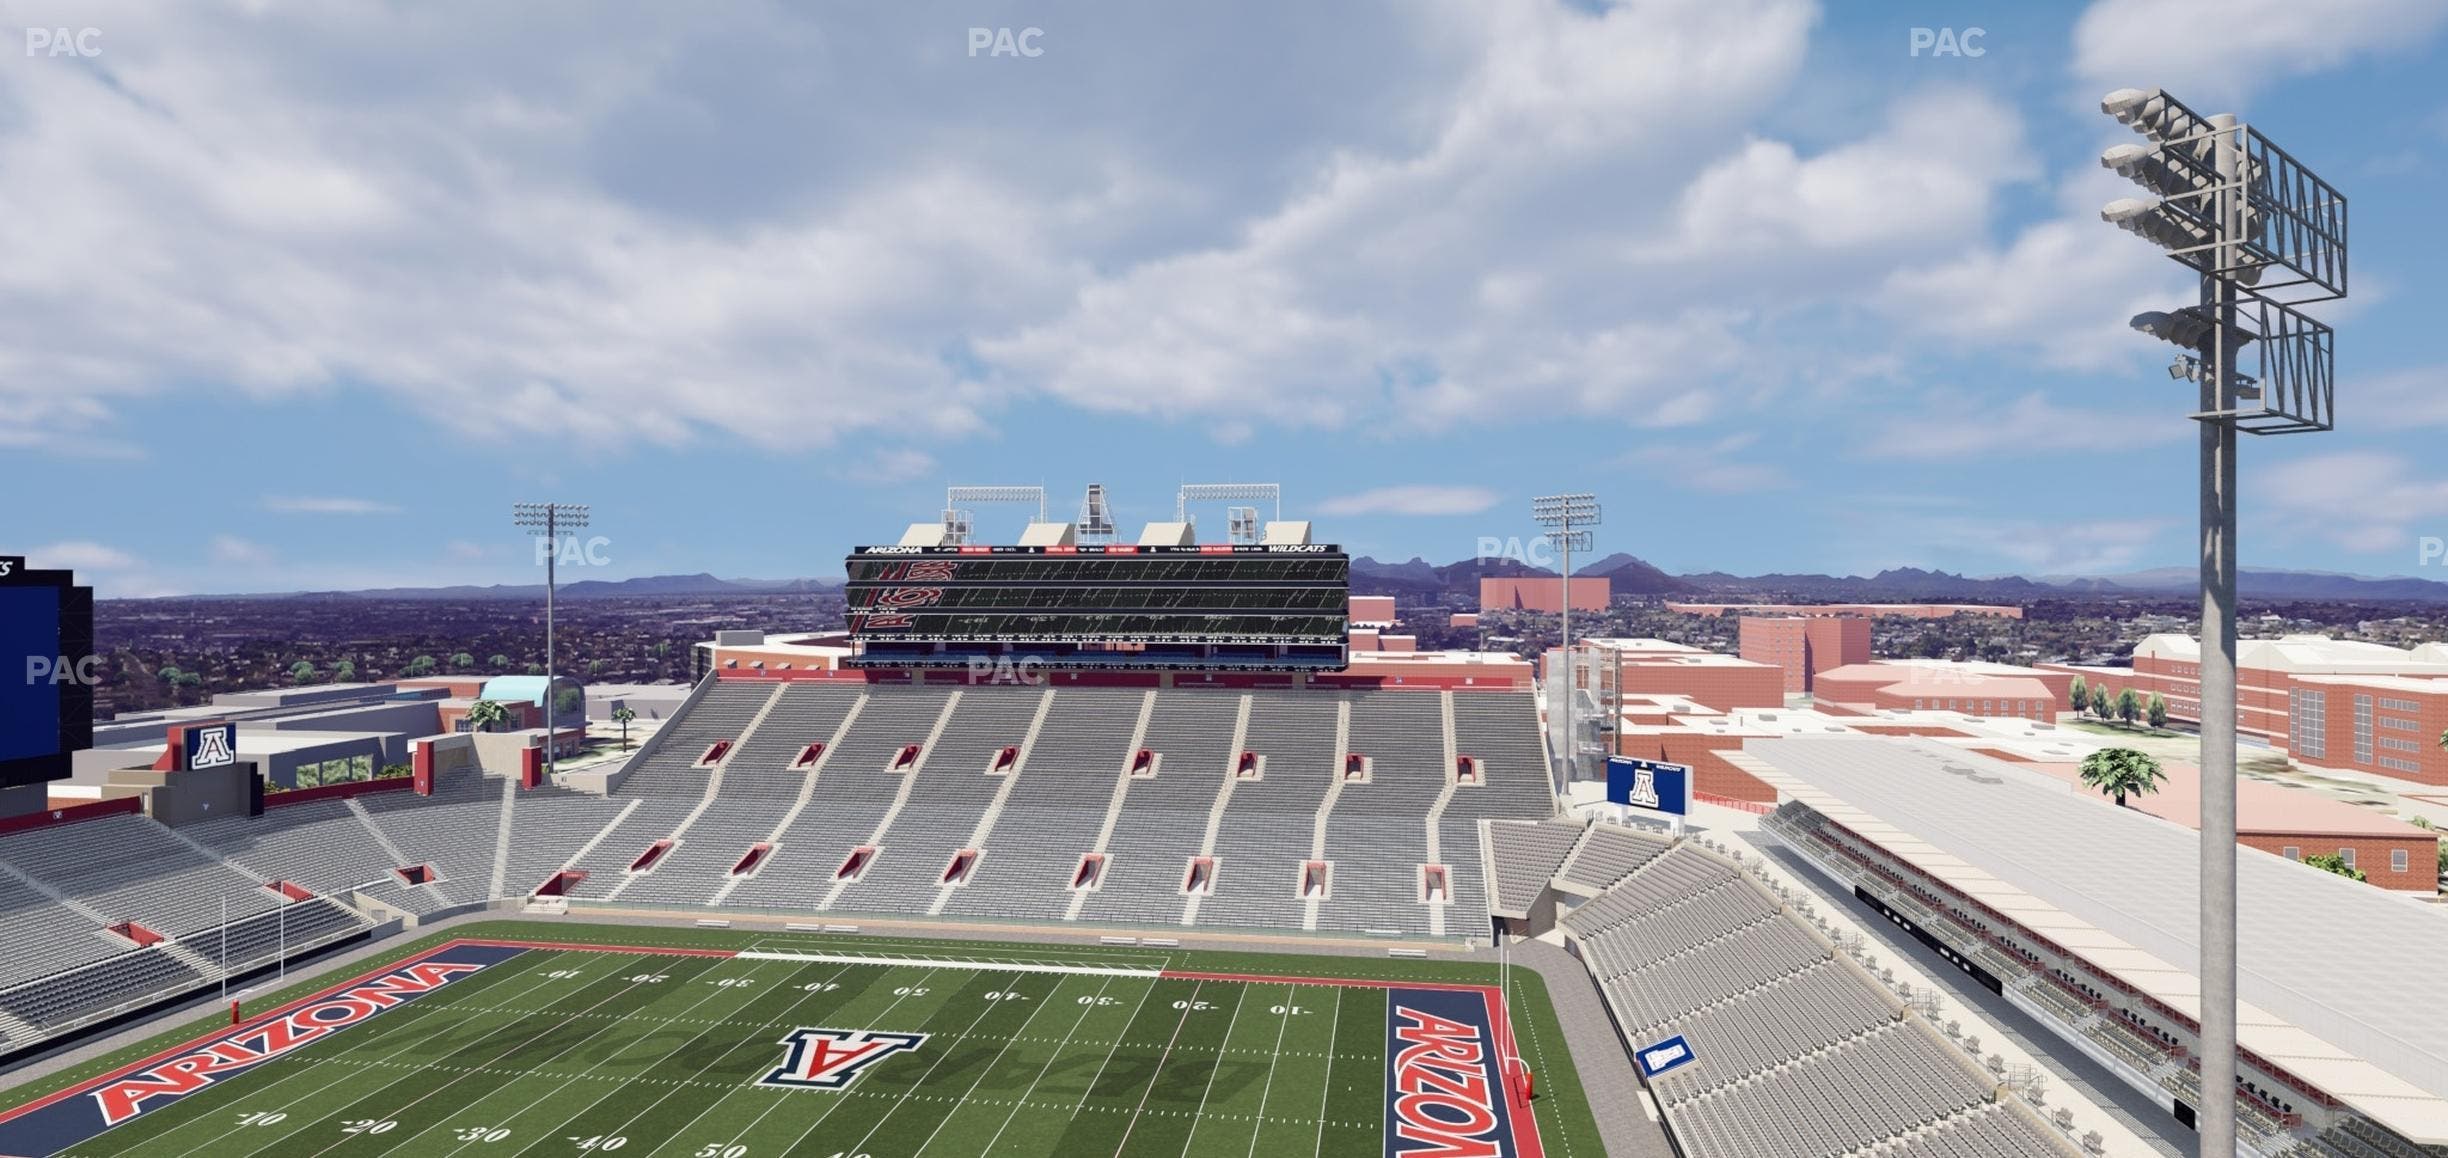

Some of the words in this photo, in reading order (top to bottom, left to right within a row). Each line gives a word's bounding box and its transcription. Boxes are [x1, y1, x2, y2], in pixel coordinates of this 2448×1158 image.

[865, 546, 922, 554] ARIZONA
[192, 727, 235, 770] A
[1629, 768, 1659, 808] A
[893, 986, 931, 997] 50
[88, 962, 487, 1127] ARIZONA
[754, 1028, 931, 1090] A
[695, 1143, 748, 1158] 50
